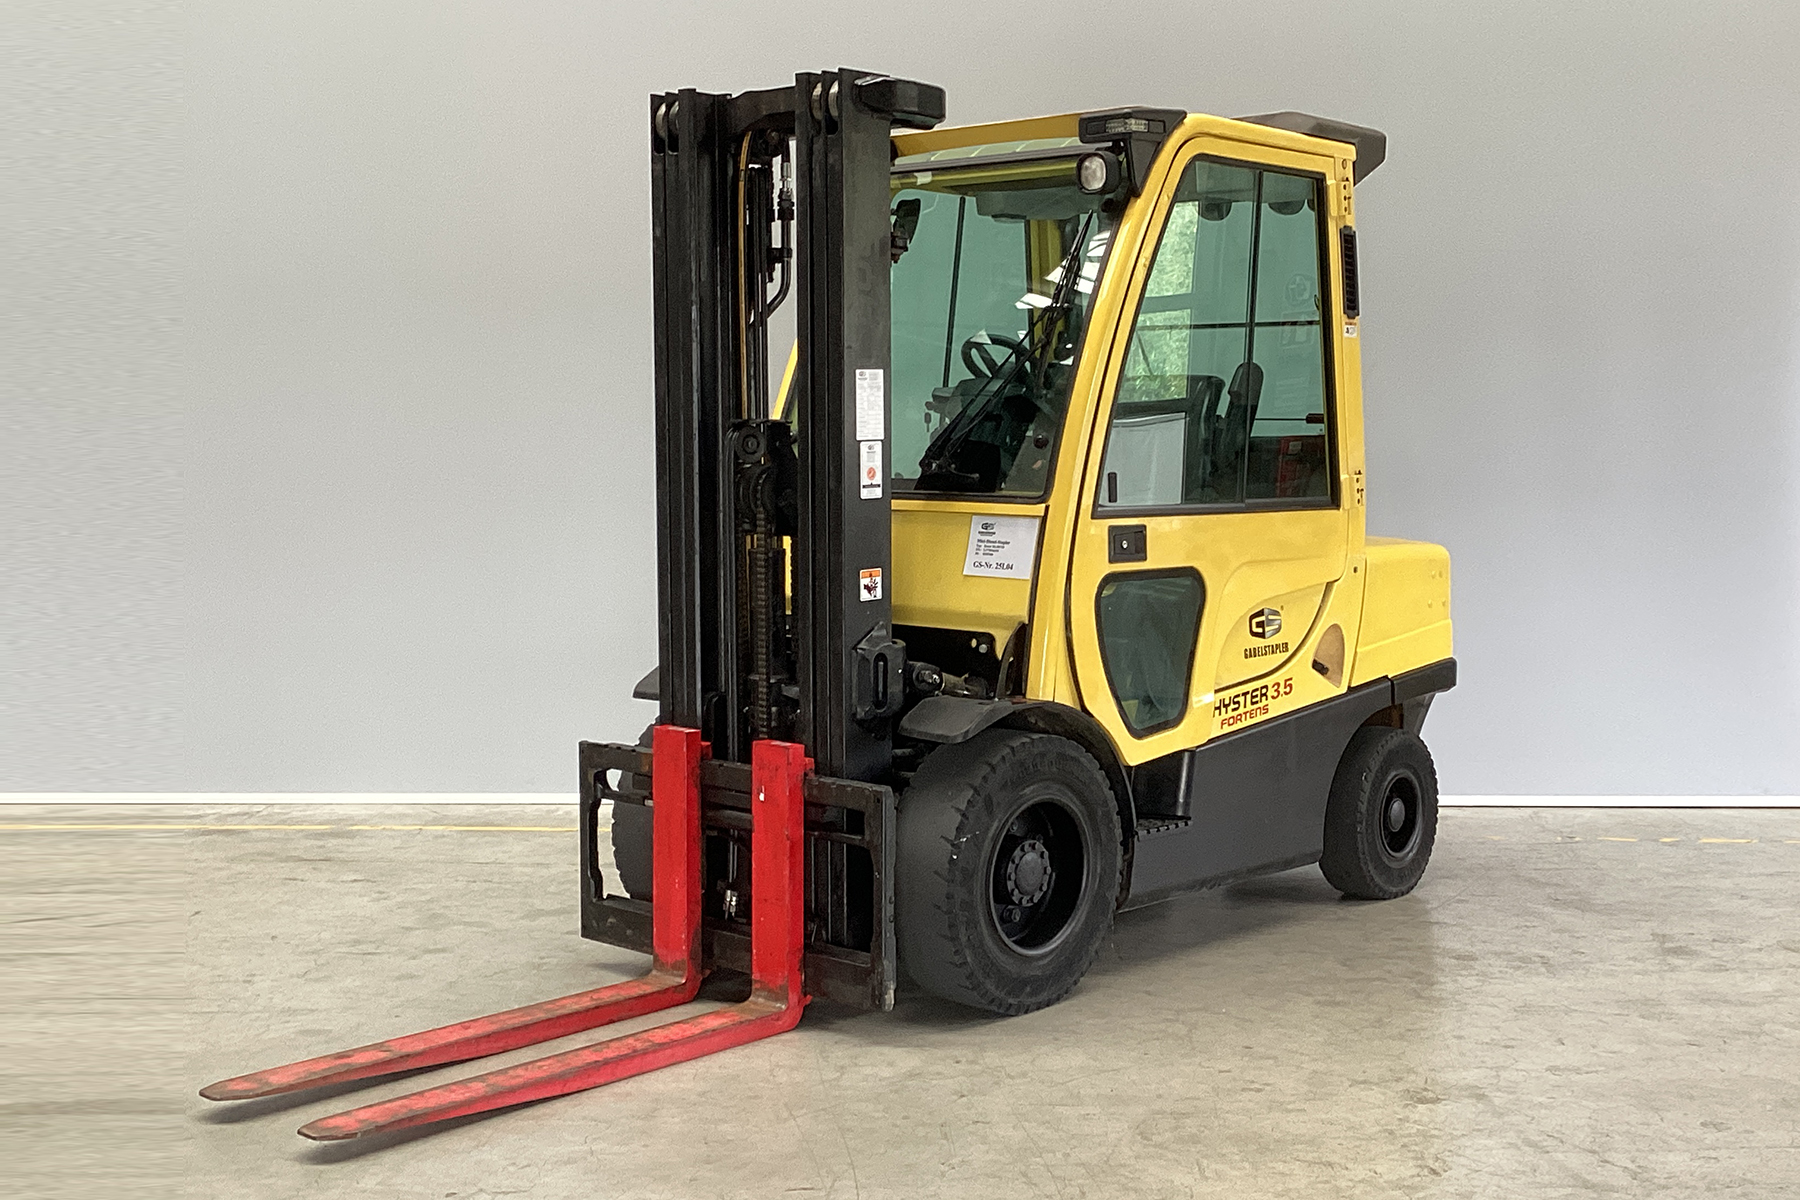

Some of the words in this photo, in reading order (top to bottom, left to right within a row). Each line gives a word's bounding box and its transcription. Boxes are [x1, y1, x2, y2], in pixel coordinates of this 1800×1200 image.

[973, 561, 993, 569] GS-Nr.
[1243, 642, 1289, 659] GABELSTAPLER
[1213, 684, 1269, 718] HYSTER
[1270, 677, 1293, 700] 3.5
[1220, 704, 1269, 730] FORTENS
